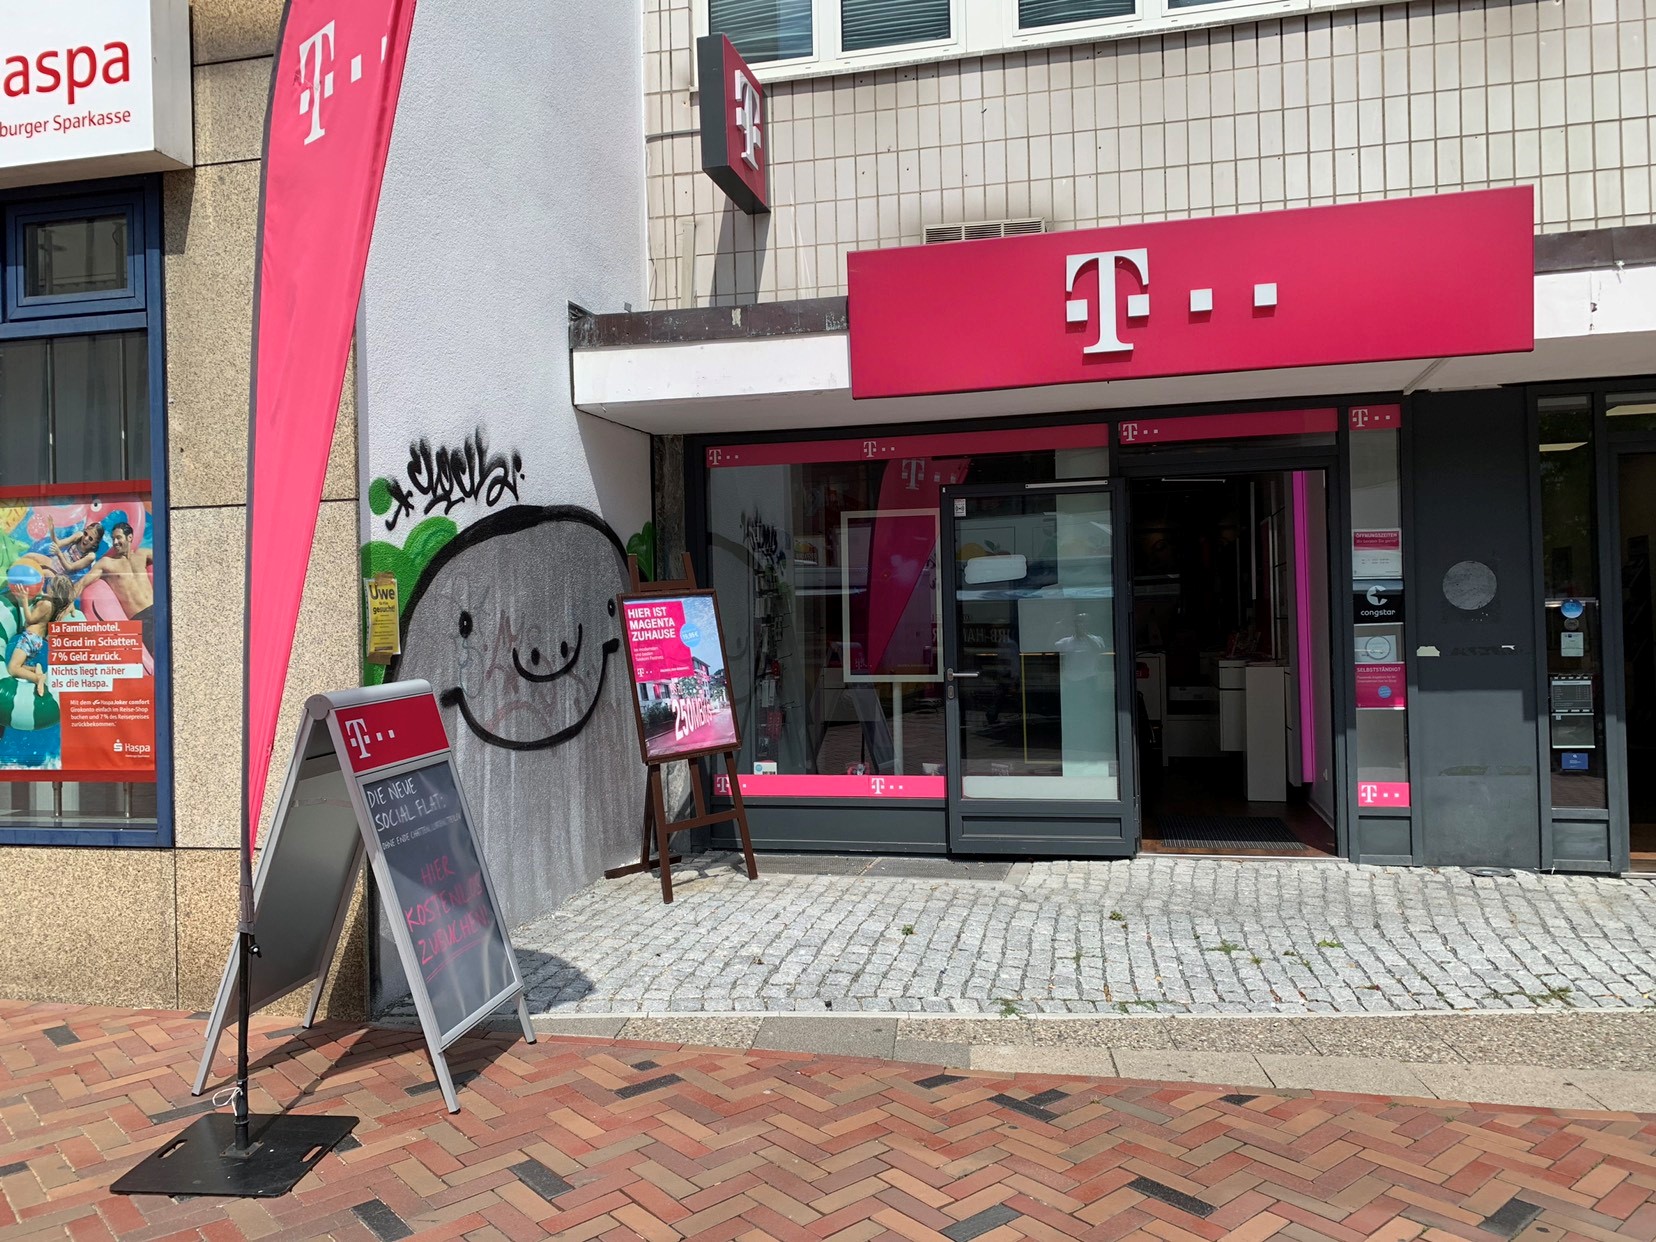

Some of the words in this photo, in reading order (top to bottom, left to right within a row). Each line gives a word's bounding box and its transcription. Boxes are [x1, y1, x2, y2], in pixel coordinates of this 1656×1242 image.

[3, 41, 129, 105] aspa
[299, 20, 335, 146] T
[0, 120, 49, 138] burger
[53, 110, 131, 133] Sparkasse
[735, 70, 762, 171] T
[1066, 248, 1150, 353] T
[1353, 409, 1368, 427] T
[1123, 424, 1138, 441] T
[709, 449, 721, 464] T
[864, 441, 876, 457] T
[369, 584, 395, 600] Uwe
[628, 608, 651, 618] HIER
[653, 607, 666, 616] IST
[52, 624, 60, 632] 1a
[62, 622, 120, 632] Familienhotel.
[630, 618, 675, 630] MAGENTA
[52, 638, 61, 647] 30
[63, 638, 83, 647] Grad
[85, 638, 96, 646] im
[98, 637, 138, 646] Schatten.
[632, 629, 676, 641] ZUHAUSE
[70, 652, 88, 661] Geld
[90, 652, 121, 661] zurück.
[52, 667, 78, 676] Nichts
[80, 667, 98, 677] liegt
[100, 666, 125, 675] näher
[52, 679, 63, 688] als
[66, 679, 79, 687] die
[81, 679, 108, 689] Haspa.
[345, 718, 371, 759] T
[125, 743, 150, 754] Haspa
[717, 777, 729, 792] T
[872, 778, 884, 794] T
[367, 786, 387, 808] DIE
[388, 778, 416, 799] NEUE
[1362, 785, 1377, 803] T
[375, 804, 415, 832] SOCIAL
[396, 831, 410, 844] ENDE
[421, 856, 455, 888] HIER
[404, 870, 482, 932] KOSTENLOS
